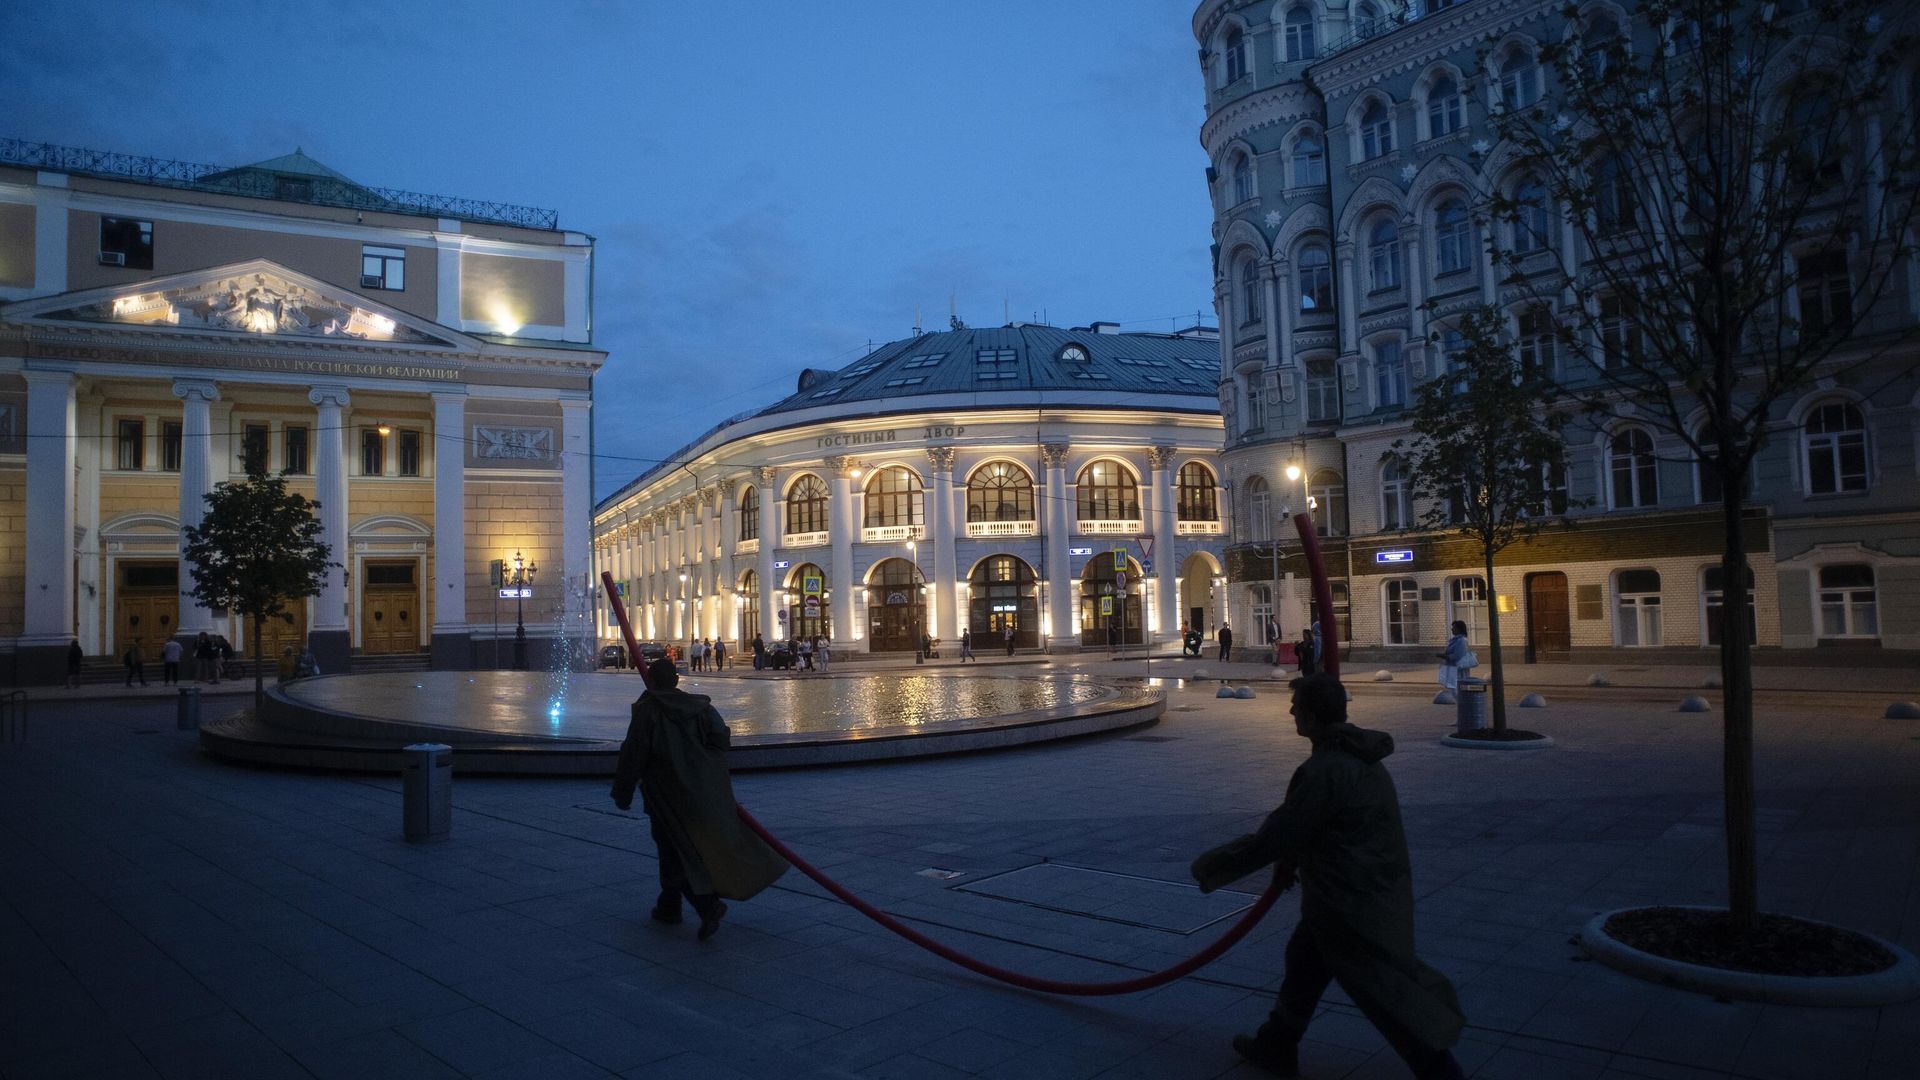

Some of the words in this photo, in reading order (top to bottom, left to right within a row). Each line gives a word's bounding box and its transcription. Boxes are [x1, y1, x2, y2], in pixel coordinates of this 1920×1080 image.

[294, 359, 382, 375] РОССИЙСКОЙ
[386, 366, 460, 380] ФЕДЕРАЦИИ
[817, 430, 896, 449] ГОСТИНЫЙ
[923, 426, 965, 440] ДВОР
